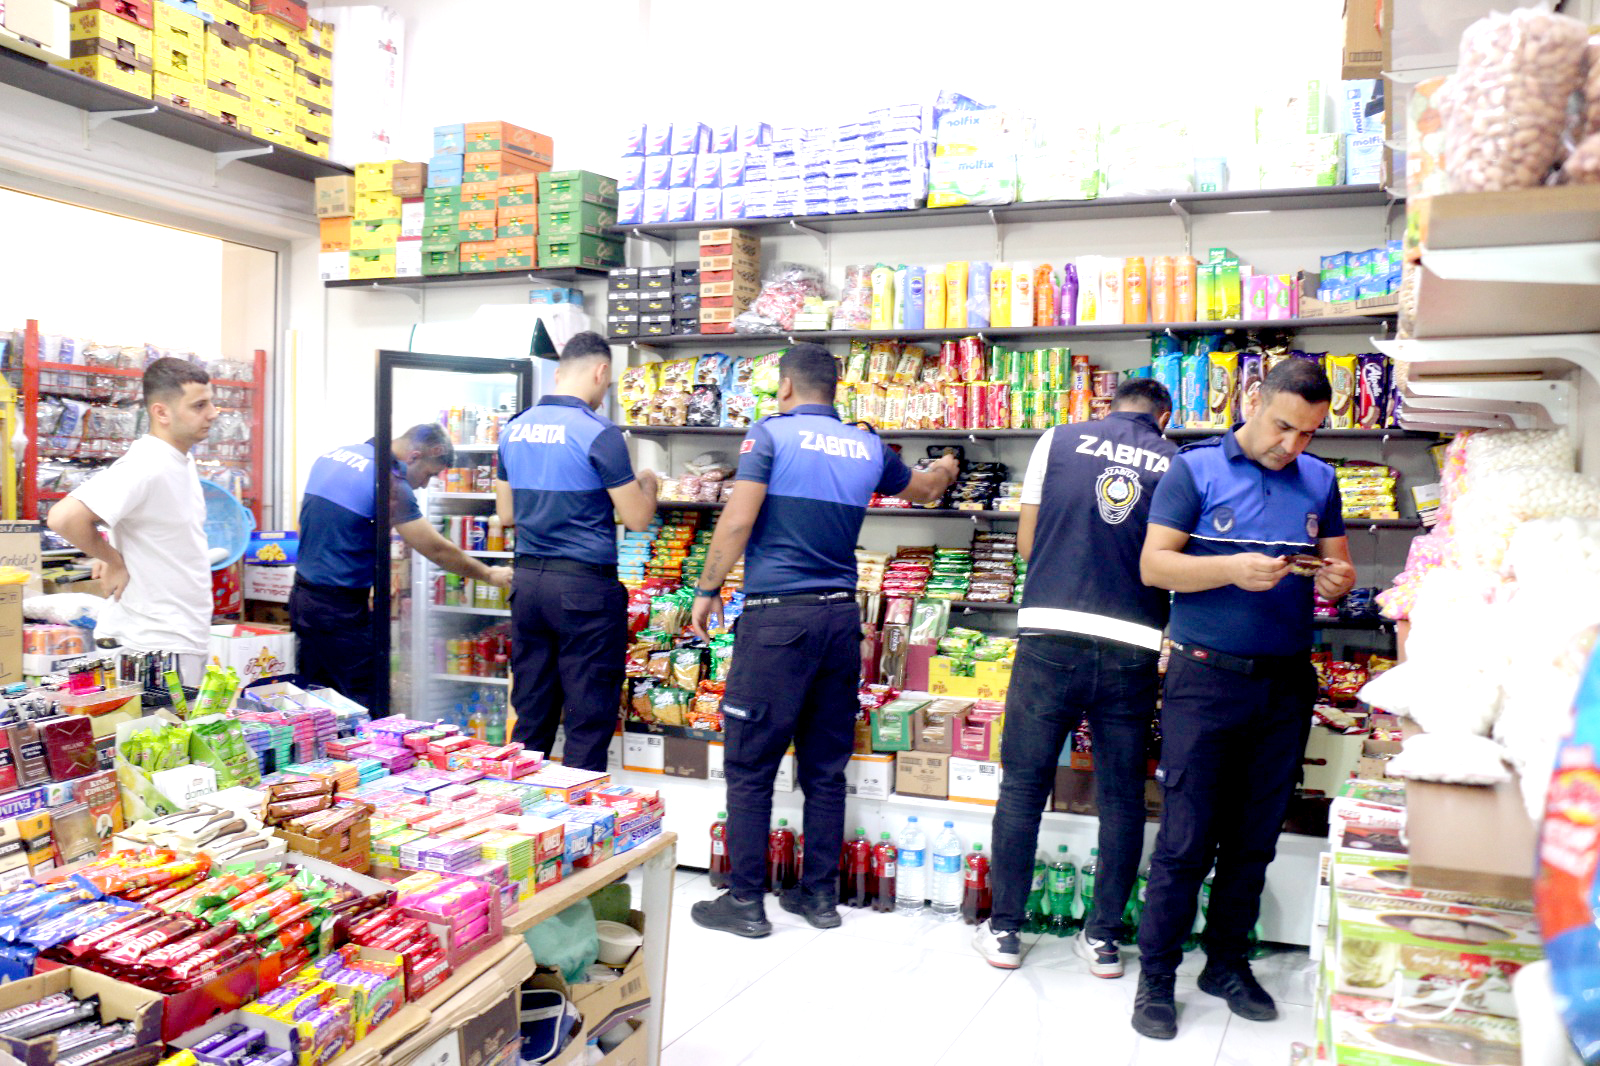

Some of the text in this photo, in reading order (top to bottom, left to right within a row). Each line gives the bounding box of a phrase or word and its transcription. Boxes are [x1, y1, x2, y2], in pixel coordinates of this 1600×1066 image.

[1351, 101, 1364, 134] molfix
[958, 160, 994, 171] molfix
[1363, 362, 1383, 397] Alpella
[509, 423, 566, 445] ZABITA
[798, 430, 871, 461] ZABITA
[1075, 434, 1171, 473] ZABITA
[1105, 467, 1137, 481] ZABITA
[84, 781, 117, 797] EDWARD
[90, 777, 110, 788] KING
[184, 778, 215, 801] damak
